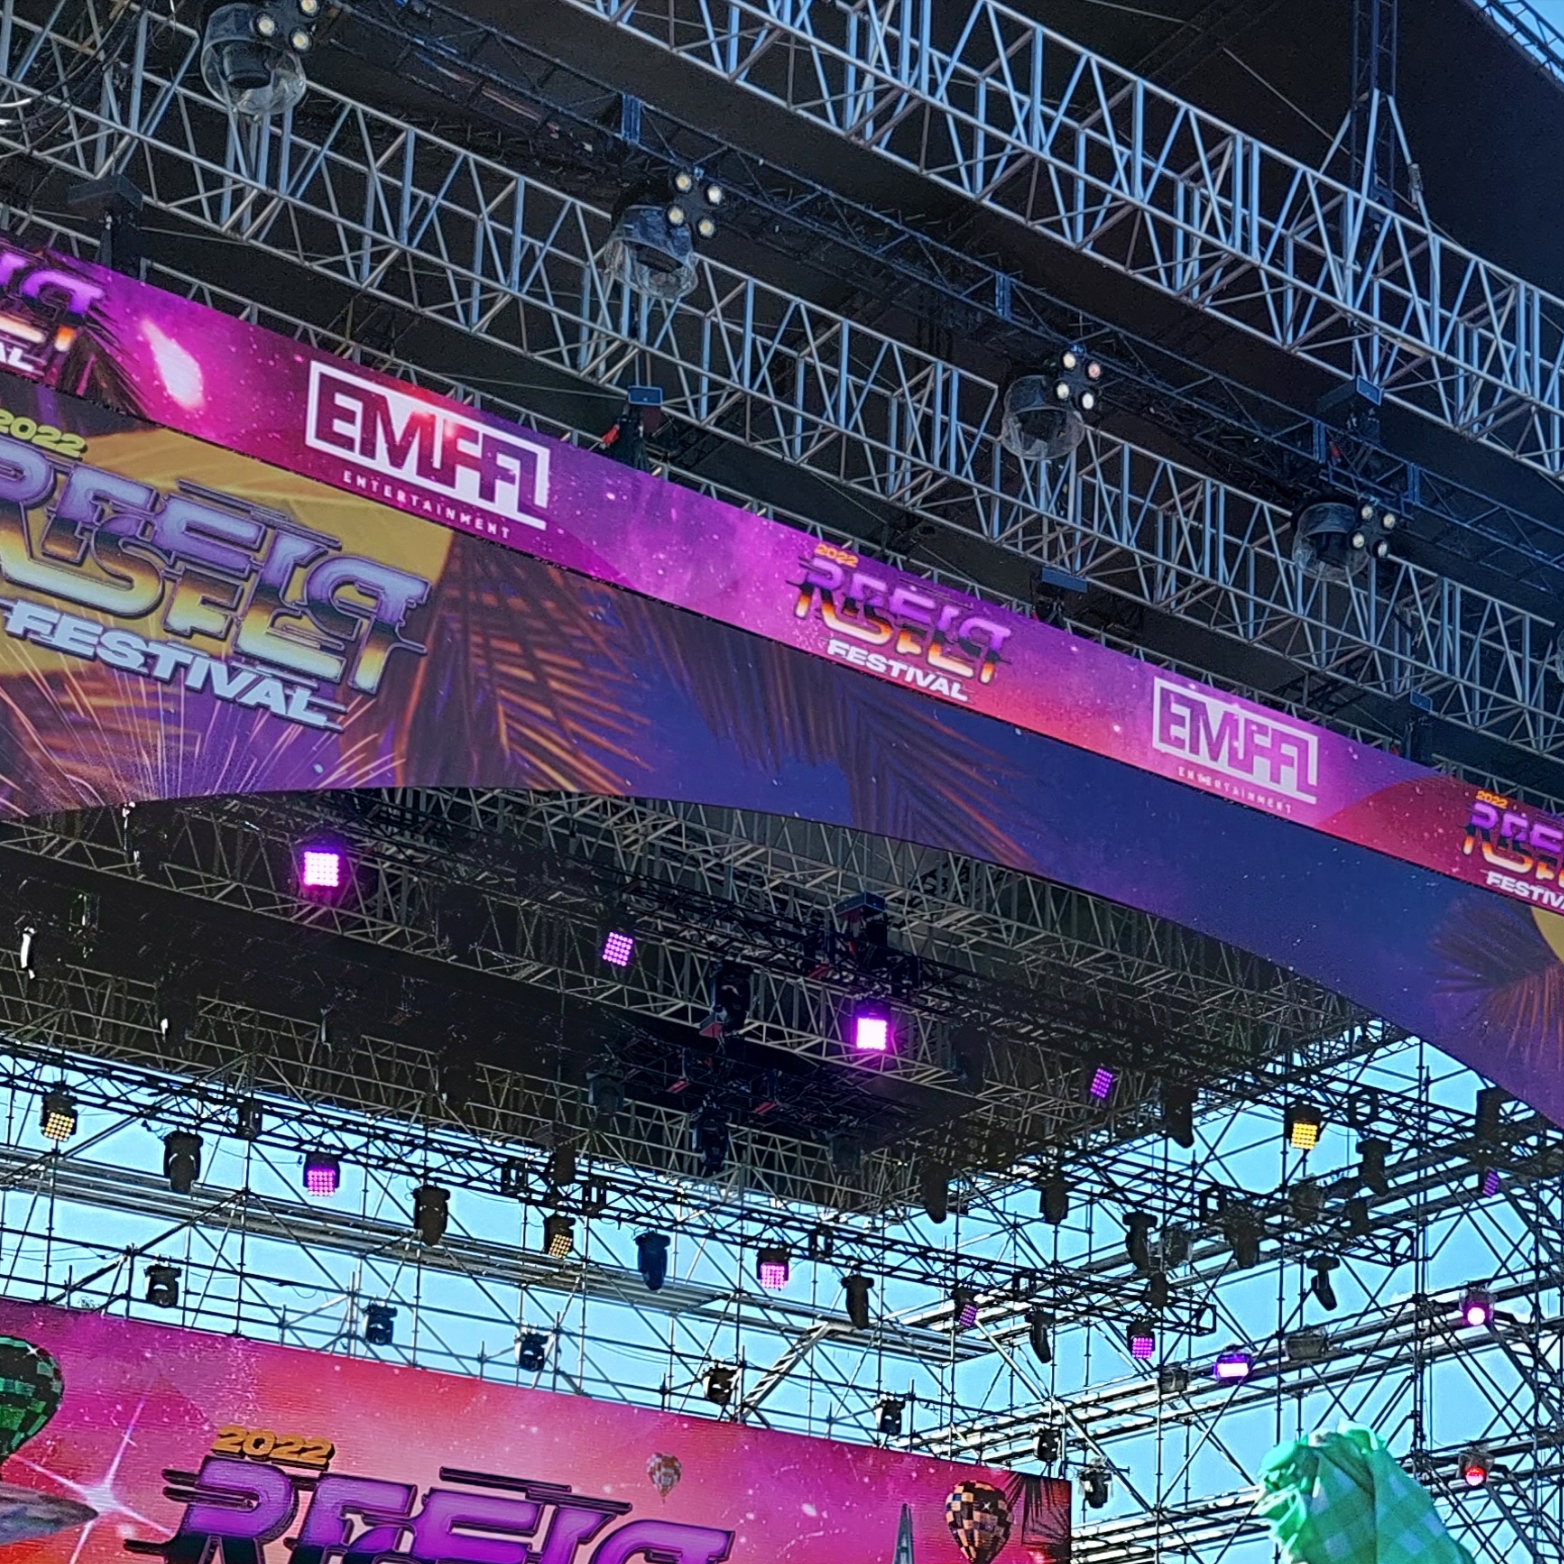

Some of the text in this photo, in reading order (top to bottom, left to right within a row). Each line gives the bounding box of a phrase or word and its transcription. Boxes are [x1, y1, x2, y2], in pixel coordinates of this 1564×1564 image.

[0, 408, 87, 459] 2022
[343, 470, 511, 539] ENTERTAINMENT
[813, 542, 859, 567] 2022
[4, 600, 345, 730] FESTIVAL
[826, 639, 970, 701] FESTIVAL
[211, 1425, 336, 1469] 2022
